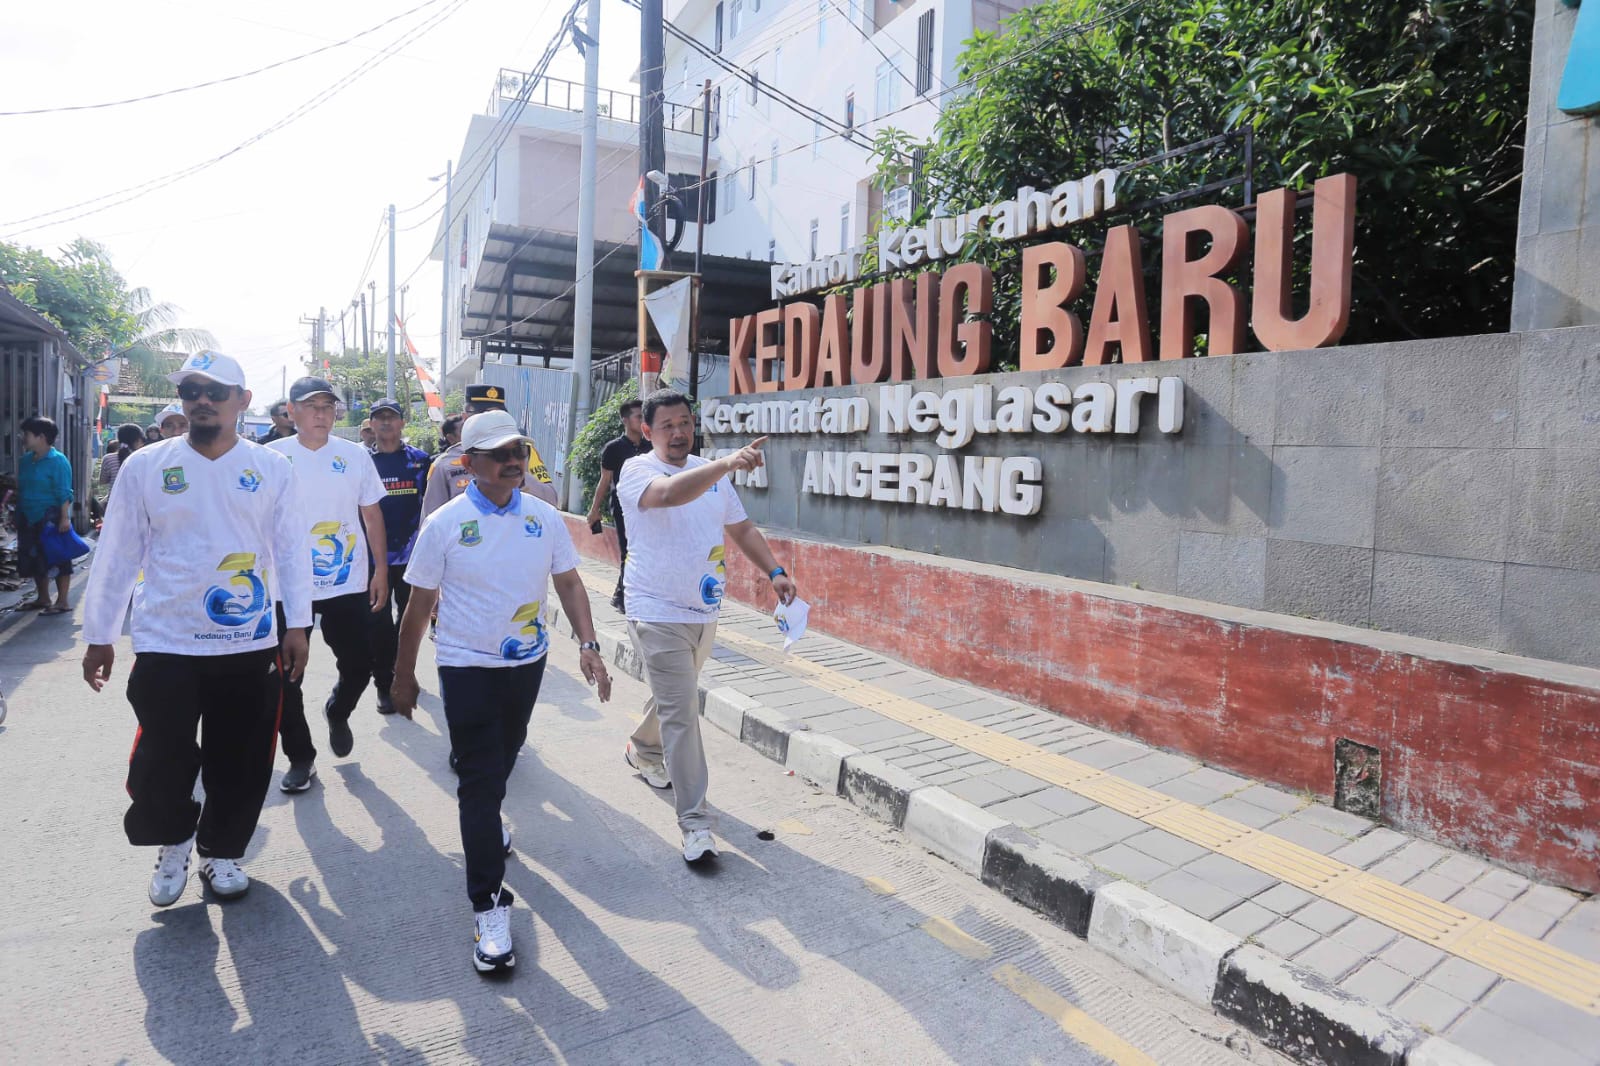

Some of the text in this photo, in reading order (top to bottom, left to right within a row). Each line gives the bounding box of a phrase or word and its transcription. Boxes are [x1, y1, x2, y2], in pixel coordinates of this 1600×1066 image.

[771, 168, 1120, 300] Kantor Kelurahan
[729, 172, 1357, 395] KEDAUNG BARU
[700, 376, 1184, 449] Kecamatan Neglasari
[802, 451, 1043, 516] ANGERANG
[194, 632, 232, 640] Kedaung
